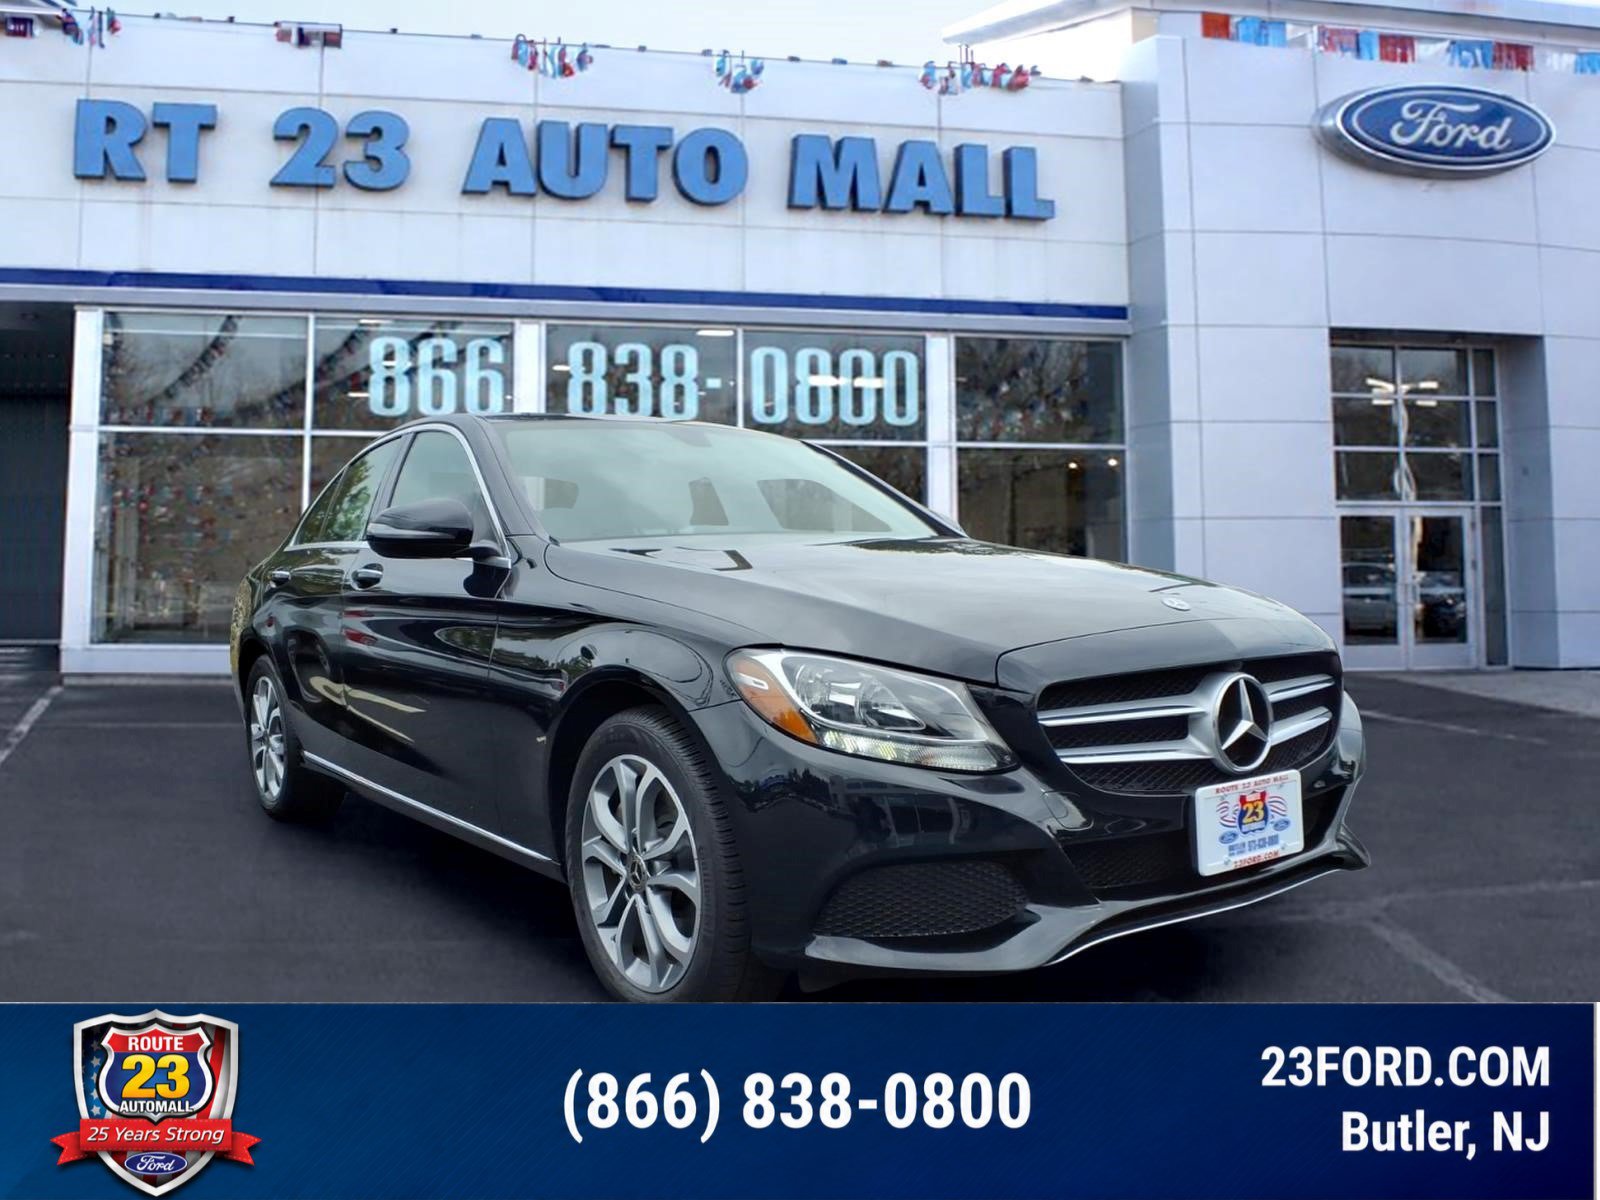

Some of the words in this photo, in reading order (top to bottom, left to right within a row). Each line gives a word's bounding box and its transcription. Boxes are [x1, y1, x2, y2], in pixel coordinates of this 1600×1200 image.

[1389, 99, 1514, 150] Ford
[73, 99, 217, 183] RT
[269, 106, 411, 192] 23
[461, 117, 748, 205] AUTO
[787, 133, 1055, 220] MALL
[368, 336, 505, 416] 866
[1242, 800, 1265, 825] 23
